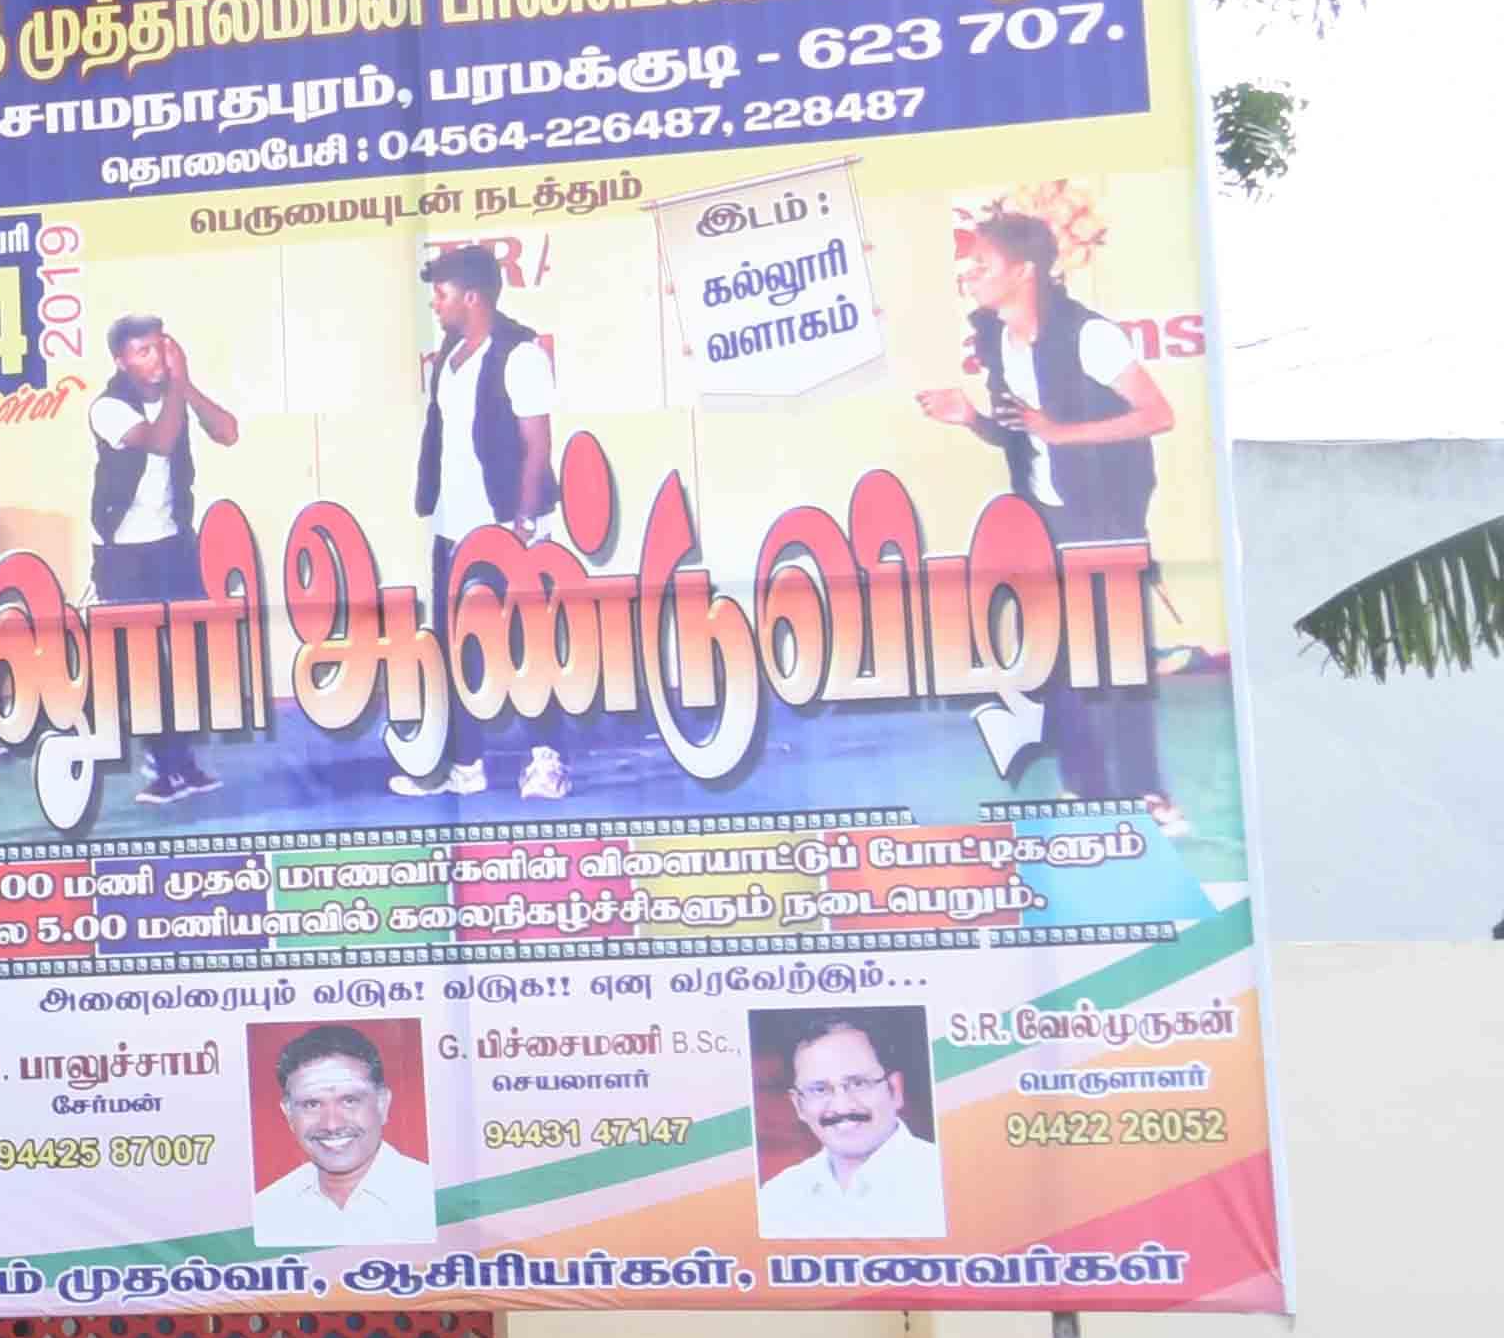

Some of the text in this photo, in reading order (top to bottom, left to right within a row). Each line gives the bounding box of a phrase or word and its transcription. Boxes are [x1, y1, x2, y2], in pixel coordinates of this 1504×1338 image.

[430, 42, 741, 108] பரமக்குடி
[798, 15, 944, 72] 623
[958, 1, 1126, 55] 707.
[101, 136, 349, 192] தொலைபேசி
[377, 104, 734, 160] 04564-226487,
[743, 87, 927, 133] 228487
[191, 170, 644, 236] பெருமையுடன் நடத்தும்
[696, 191, 810, 238] இடம்
[39, 224, 83, 359] 2019
[702, 238, 850, 310] கல்லூரி
[707, 293, 859, 365] வளாகம்
[63, 867, 154, 899] மணி
[164, 858, 271, 901] முதல்
[279, 843, 569, 889] மாணவர்களின்
[578, 838, 859, 882] விளையாட்டுப்
[868, 825, 1144, 870] போட்டிகளும்
[37, 912, 126, 944] 5.00
[137, 900, 378, 941] மணியளவில்
[388, 885, 773, 935] கலைநிகழ்ச்சிகளும்
[781, 876, 1048, 926] நடைபெறும்.
[40, 979, 296, 1015] அனைவரையும்
[314, 977, 424, 1007] வருக!
[443, 975, 575, 1004] வருக!!
[589, 971, 651, 1002] என
[438, 1034, 468, 1060] G.
[476, 1024, 662, 1060] பிச்சைமணி
[950, 998, 1235, 1045] S.R. வேல்முருகன்
[19, 1040, 219, 1089] பாலுச்சாமி
[492, 1068, 651, 1093] செயலாளர்
[1019, 1065, 1207, 1095] பொருளாளர்
[52, 1092, 164, 1116] சேர்மன்
[1007, 1108, 1227, 1148] 94422 26052
[109, 1134, 216, 1167] 87007
[483, 1117, 693, 1150] 94431 47147
[58, 1256, 327, 1303] முதல்வர்,
[343, 1247, 755, 1293] ஆசிரியர்கள்,
[769, 1243, 1186, 1290] மாணவர்கள்
